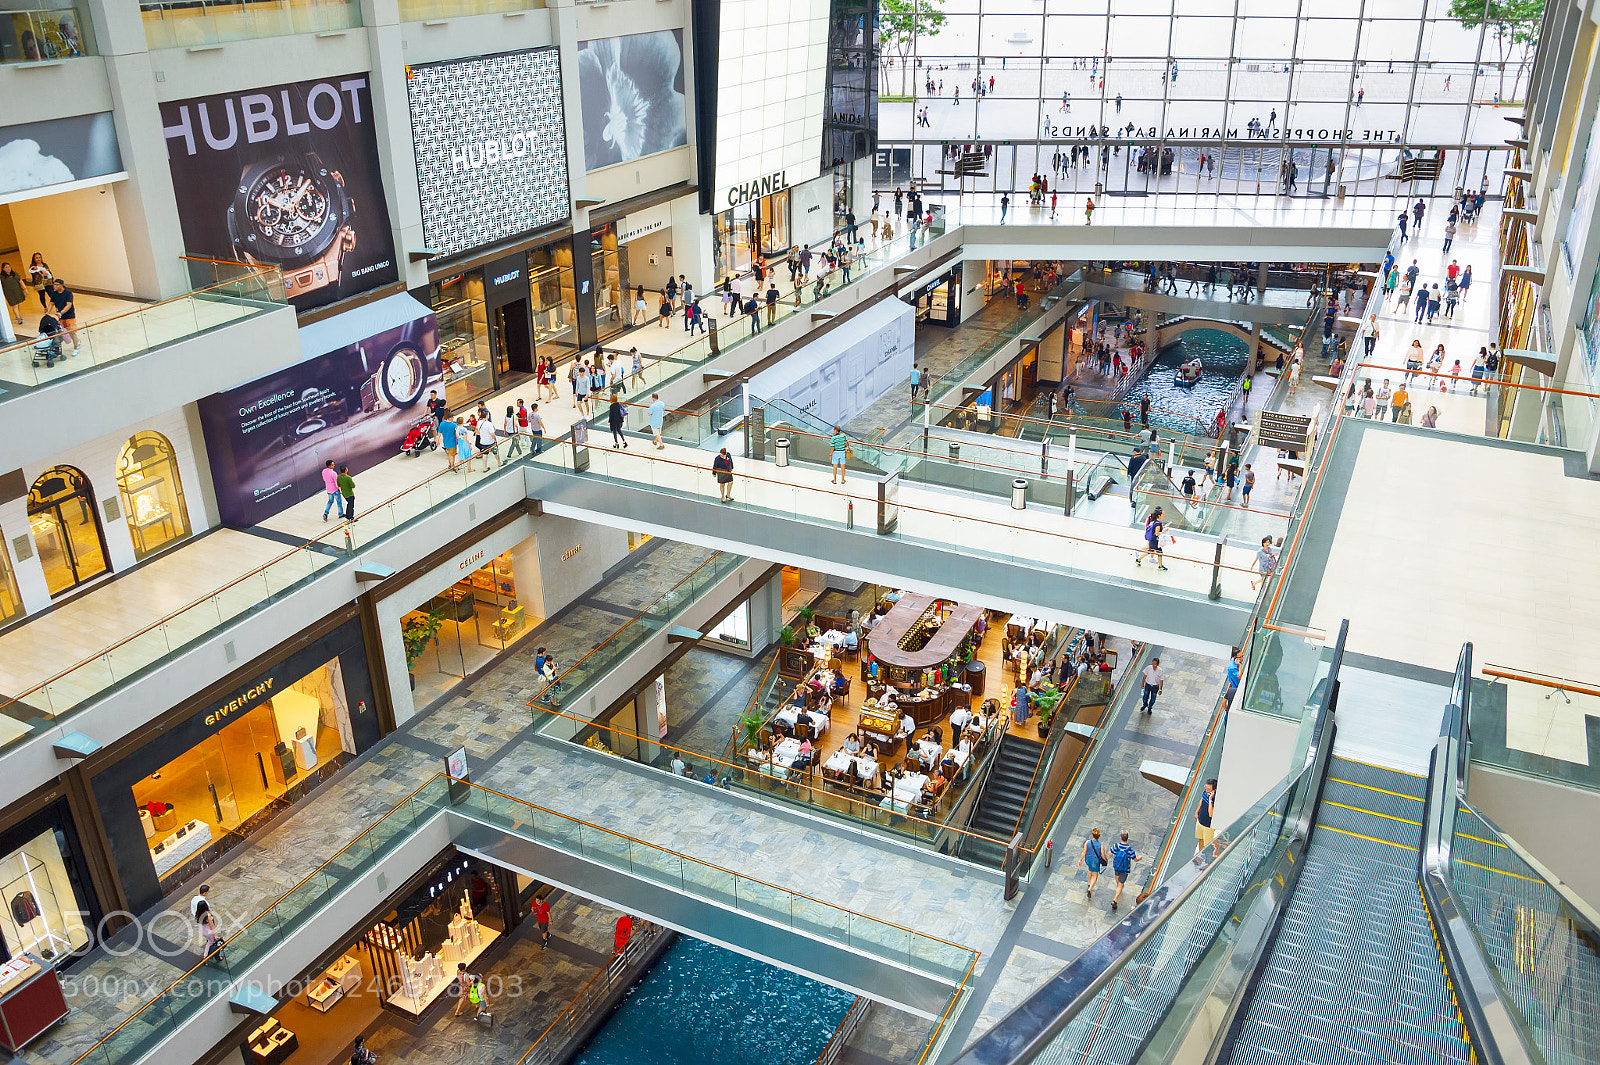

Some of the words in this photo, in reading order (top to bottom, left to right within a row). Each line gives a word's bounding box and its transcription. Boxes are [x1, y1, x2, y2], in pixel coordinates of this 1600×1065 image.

[162, 78, 367, 160] HUBLOT
[451, 130, 538, 174] HUBLOT
[728, 170, 789, 207] CHANEL
[351, 269, 361, 278] BIG
[361, 265, 375, 275] BANG
[375, 260, 390, 270] UNICO
[493, 269, 520, 286] HUBLOT
[238, 404, 257, 417] Own
[257, 389, 295, 410] Excellence
[205, 677, 274, 726] GIVENCHY
